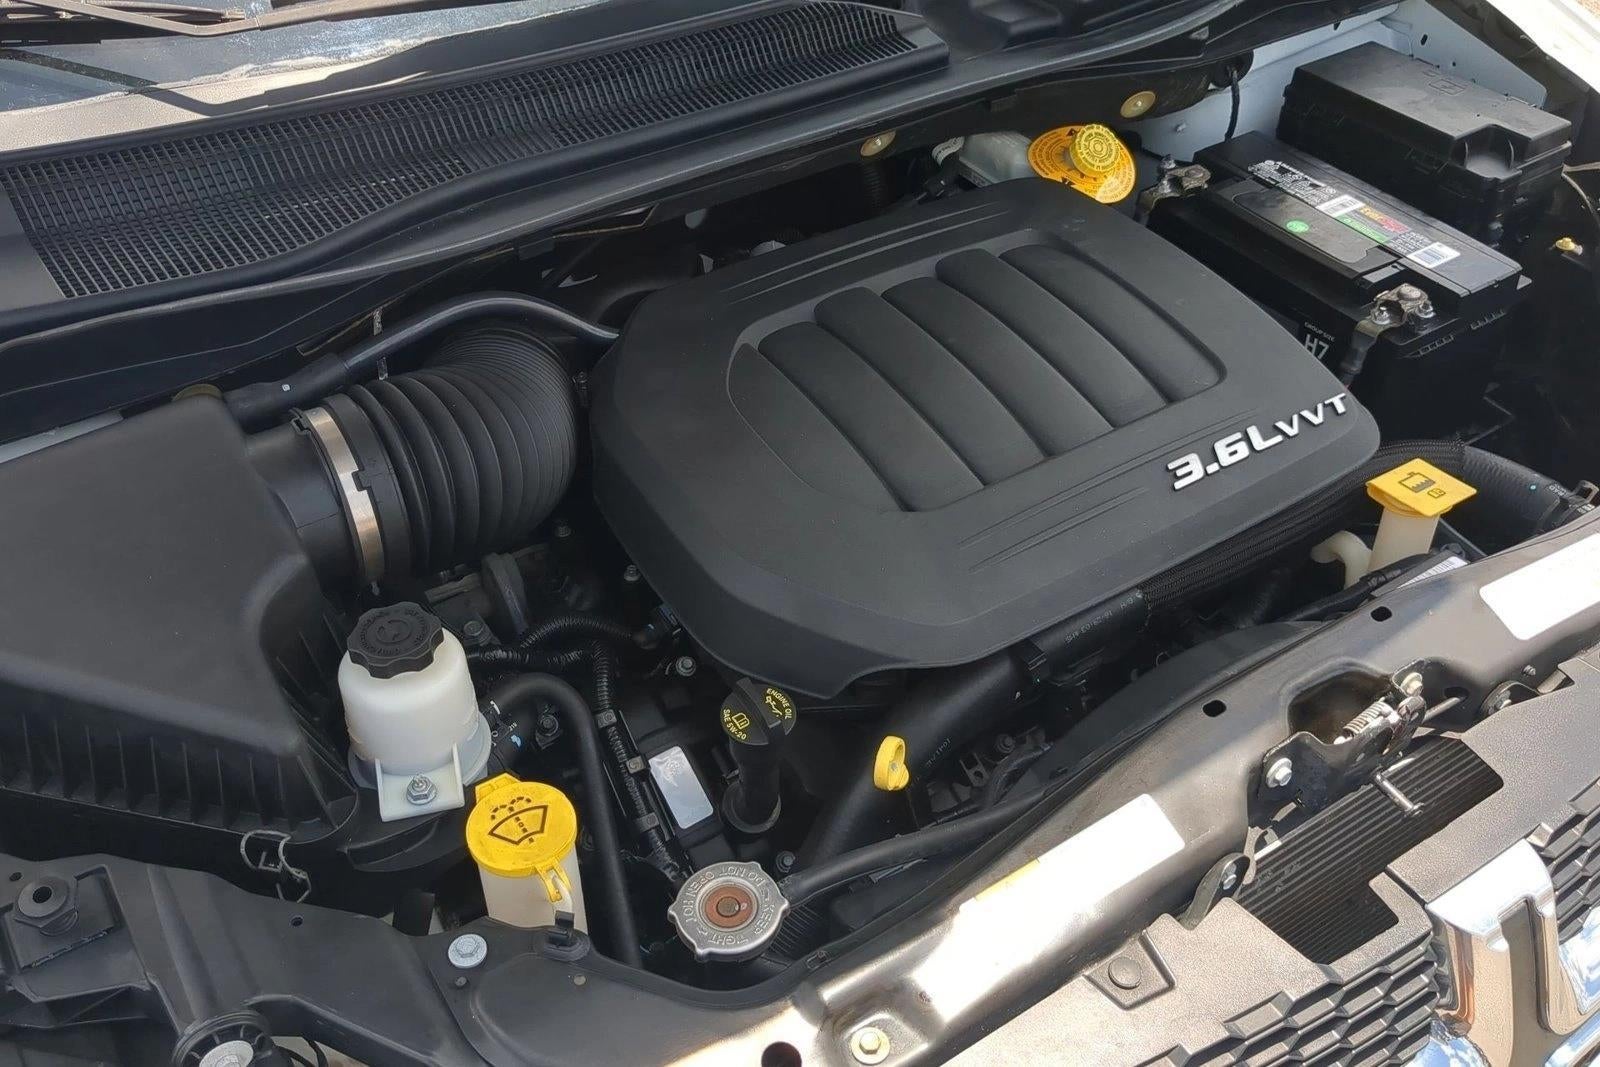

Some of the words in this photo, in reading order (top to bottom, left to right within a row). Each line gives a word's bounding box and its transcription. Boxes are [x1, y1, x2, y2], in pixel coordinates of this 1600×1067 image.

[1304, 333, 1329, 360] H7
[766, 687, 790, 708] ENGINE
[784, 708, 792, 720] OIL
[723, 708, 731, 722] SAE
[726, 722, 747, 740] 5W-20
[718, 866, 746, 878] NOT
[683, 900, 697, 922] HOT
[753, 904, 774, 935] KEEP
[707, 934, 749, 946] TIGHT
